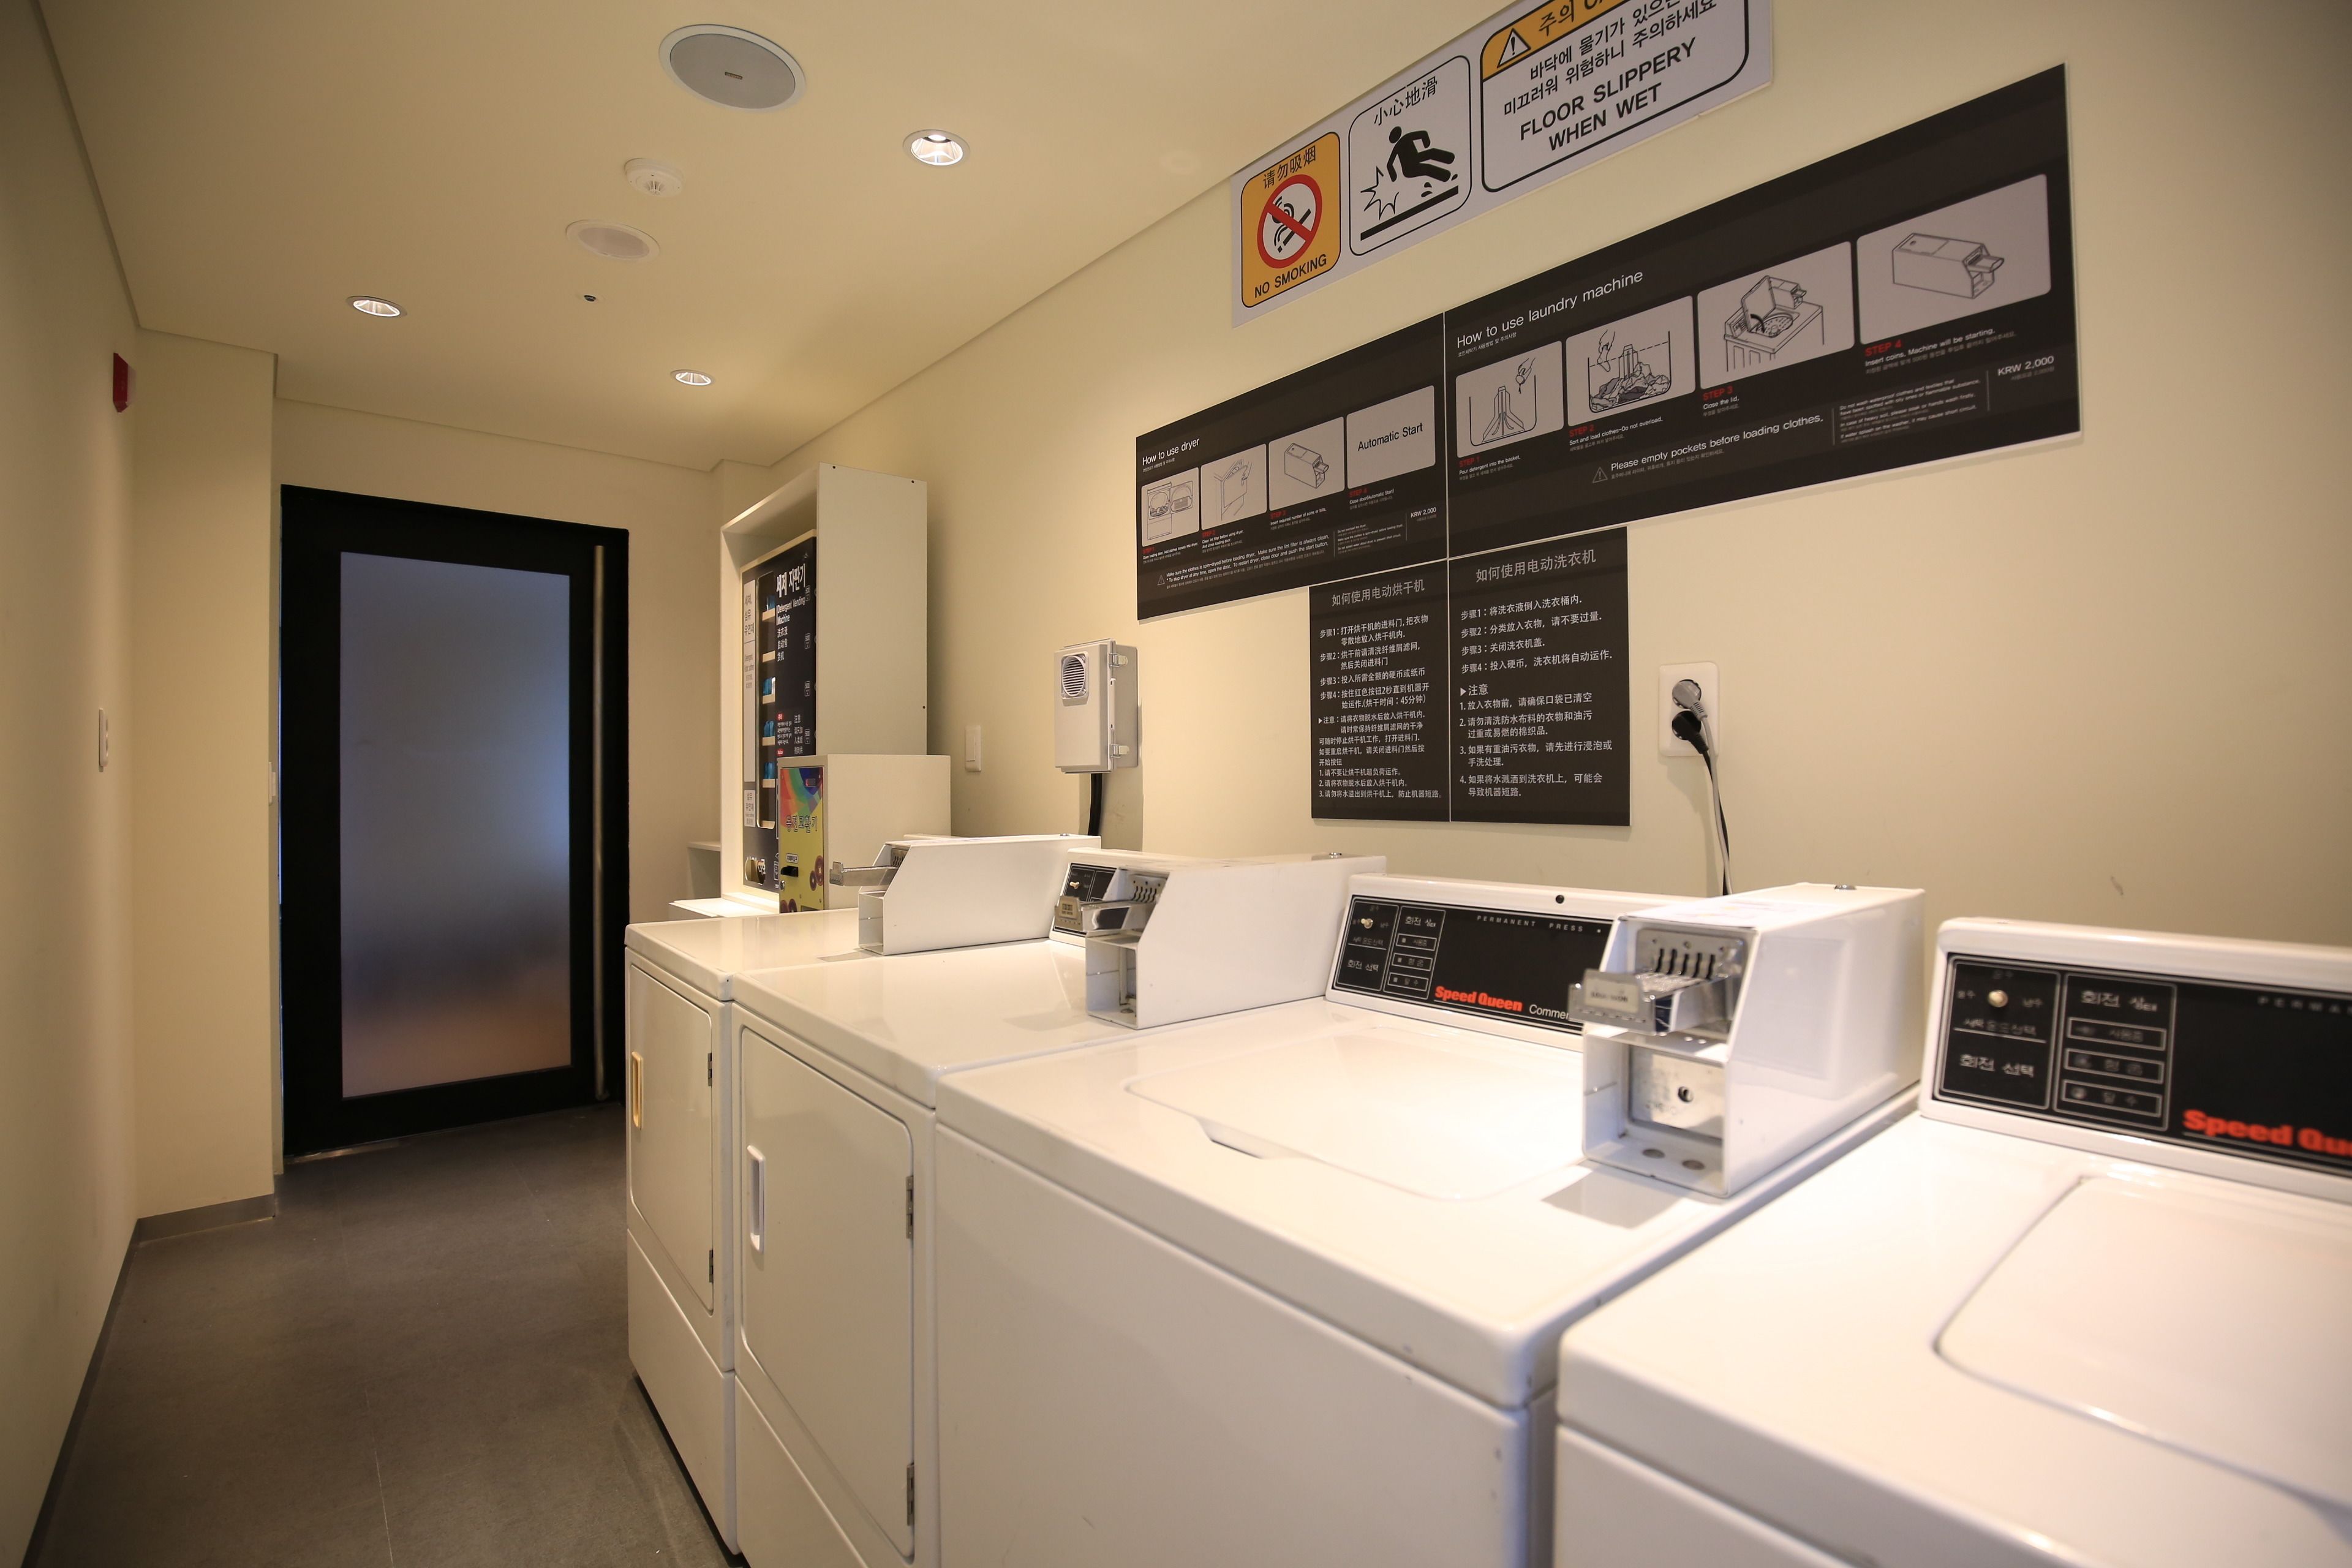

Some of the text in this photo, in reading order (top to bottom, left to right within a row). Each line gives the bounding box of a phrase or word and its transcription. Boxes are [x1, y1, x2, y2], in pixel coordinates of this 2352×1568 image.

[1539, 5, 1575, 37] 주의
[1504, 0, 1717, 116] 미끄러워 위험하니 주의하세요
[1530, 46, 1573, 80] 바닥에
[1579, 17, 1626, 55] 물기가
[1374, 75, 1438, 126] 小心地滑
[1521, 37, 1696, 141] FLOOR SLIPPERY
[1549, 82, 1662, 151] WHEN WET
[1263, 145, 1317, 189] 请勿吸烟
[1254, 253, 1327, 298] NO SMOKING
[1457, 272, 1643, 348] How to use laundry machine
[1865, 357, 1883, 366] Insert
[1885, 353, 1906, 361] coins.
[1908, 344, 1937, 355] Machine
[1964, 329, 1995, 340] starting.
[1865, 343, 1892, 355] STEP
[1997, 364, 2021, 375] KRW
[2024, 356, 2054, 369] 2,000
[1703, 385, 1733, 400] STEP 3
[1569, 426, 1588, 436] STEP
[1639, 417, 1663, 426] overload.
[1357, 423, 1423, 451] Automatic Start
[1610, 460, 1638, 470] Please
[1642, 452, 1668, 464] empty
[1671, 443, 1706, 458] pockets
[1709, 435, 1740, 447] before
[1743, 425, 1779, 439] loading
[1782, 415, 1823, 429] clothes.
[1142, 455, 1156, 466] How
[1166, 447, 1179, 456] use
[1181, 439, 1199, 451] dryer
[1469, 464, 1488, 472] detergent
[1476, 549, 1596, 582] 如何使用电动洗衣机
[776, 571, 787, 598] 세제
[788, 563, 805, 592] 자판기
[1332, 579, 1425, 606] 如何使用电动烘干机
[777, 596, 805, 614] Detergent Vending
[777, 614, 790, 625] Machine
[1341, 657, 1388, 670] 然后关闭进料门
[1468, 684, 1488, 696] 注意
[786, 815, 817, 833] 동전교환기
[1405, 916, 1421, 926] 회전
[1477, 915, 1584, 932] PERMANENT PRESS
[1348, 960, 1379, 972] 회전 선택
[1435, 986, 1476, 1005] Speed
[1478, 992, 1523, 1012] Queen
[2081, 990, 2120, 1008] 회전
[1959, 1054, 2034, 1078] 회전 선택
[2183, 1109, 2293, 1146] Speed
